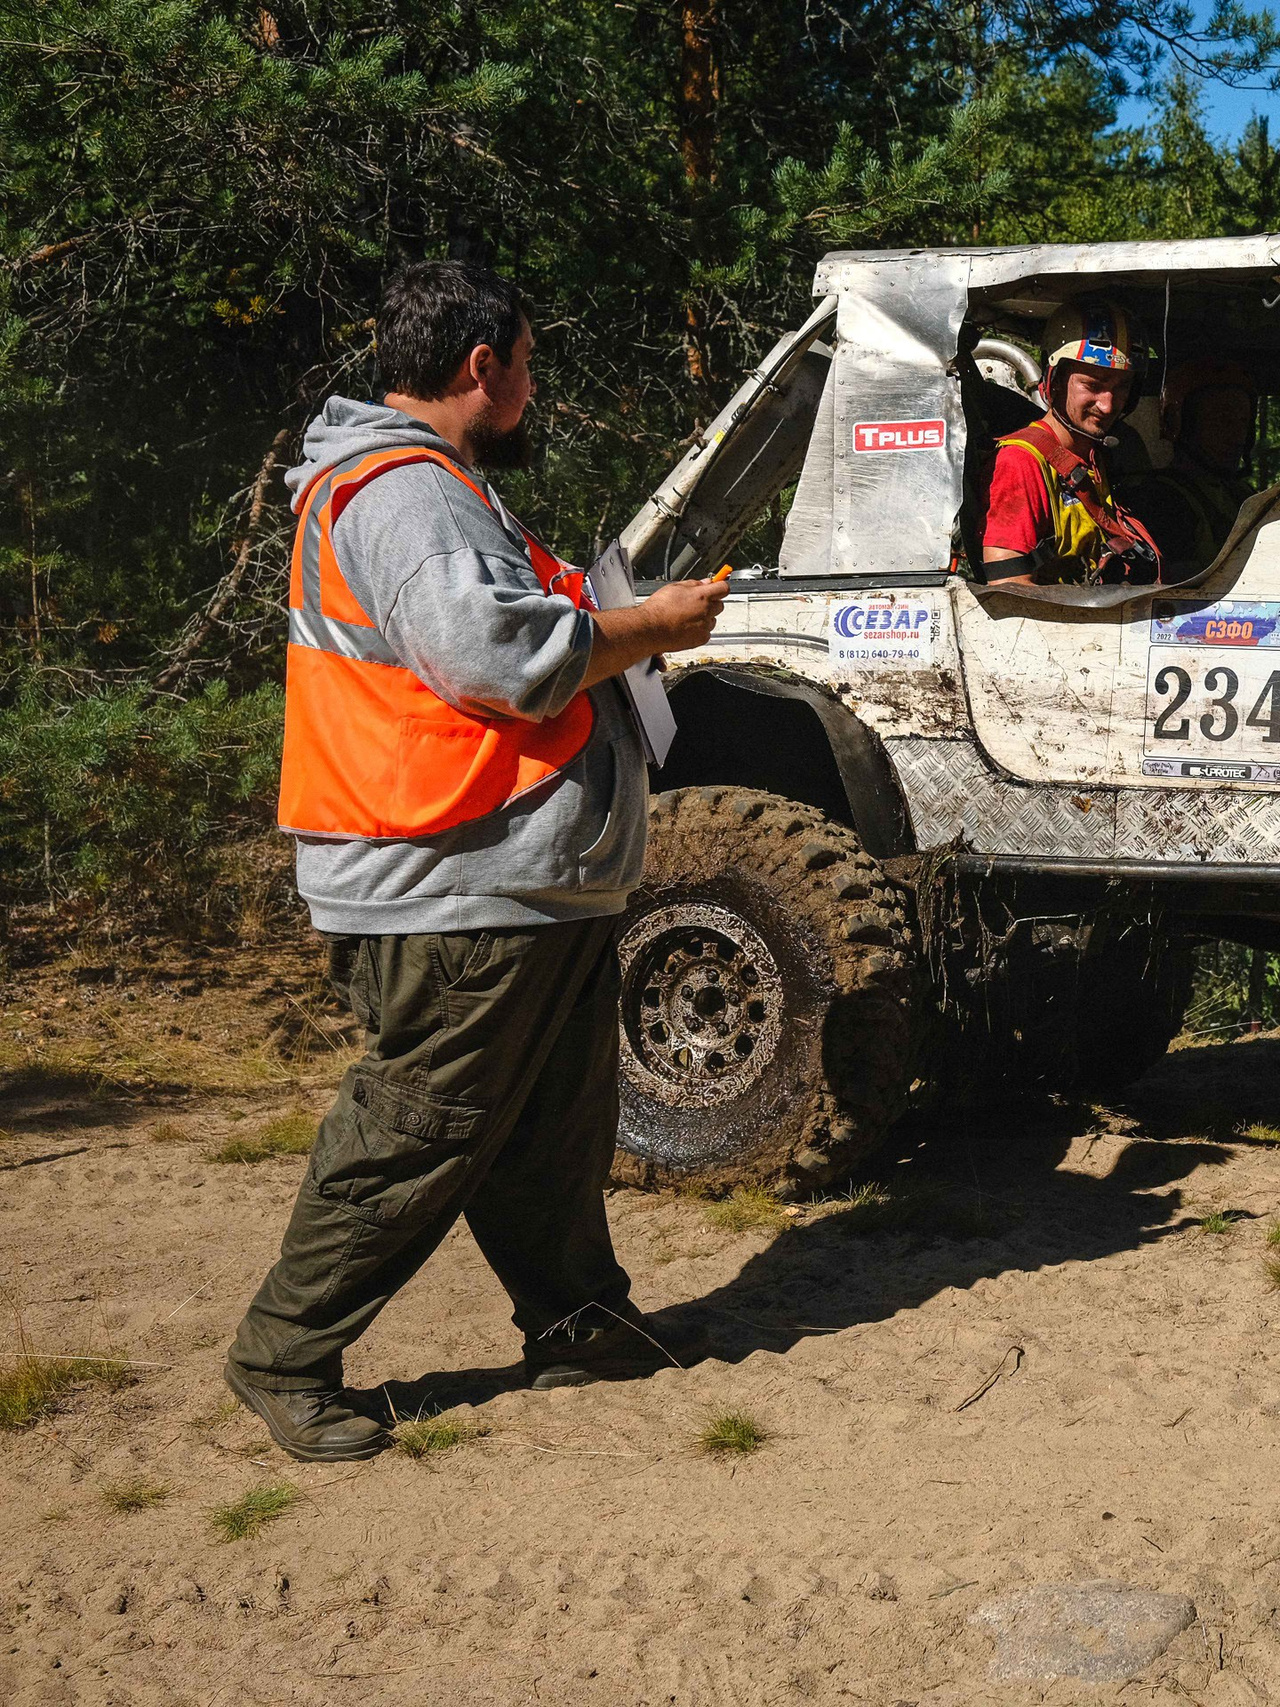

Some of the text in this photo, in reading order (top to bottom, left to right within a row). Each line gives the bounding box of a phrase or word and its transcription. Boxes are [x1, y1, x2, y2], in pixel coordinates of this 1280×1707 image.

[859, 428, 940, 447] TPLUS
[851, 610, 928, 630] СЕЗАР
[863, 630, 920, 641] sezarshop.ru
[1156, 633, 1172, 641] 2022
[1205, 620, 1254, 640] СЗФО
[839, 649, 920, 660] 8 (812) 640-79-40
